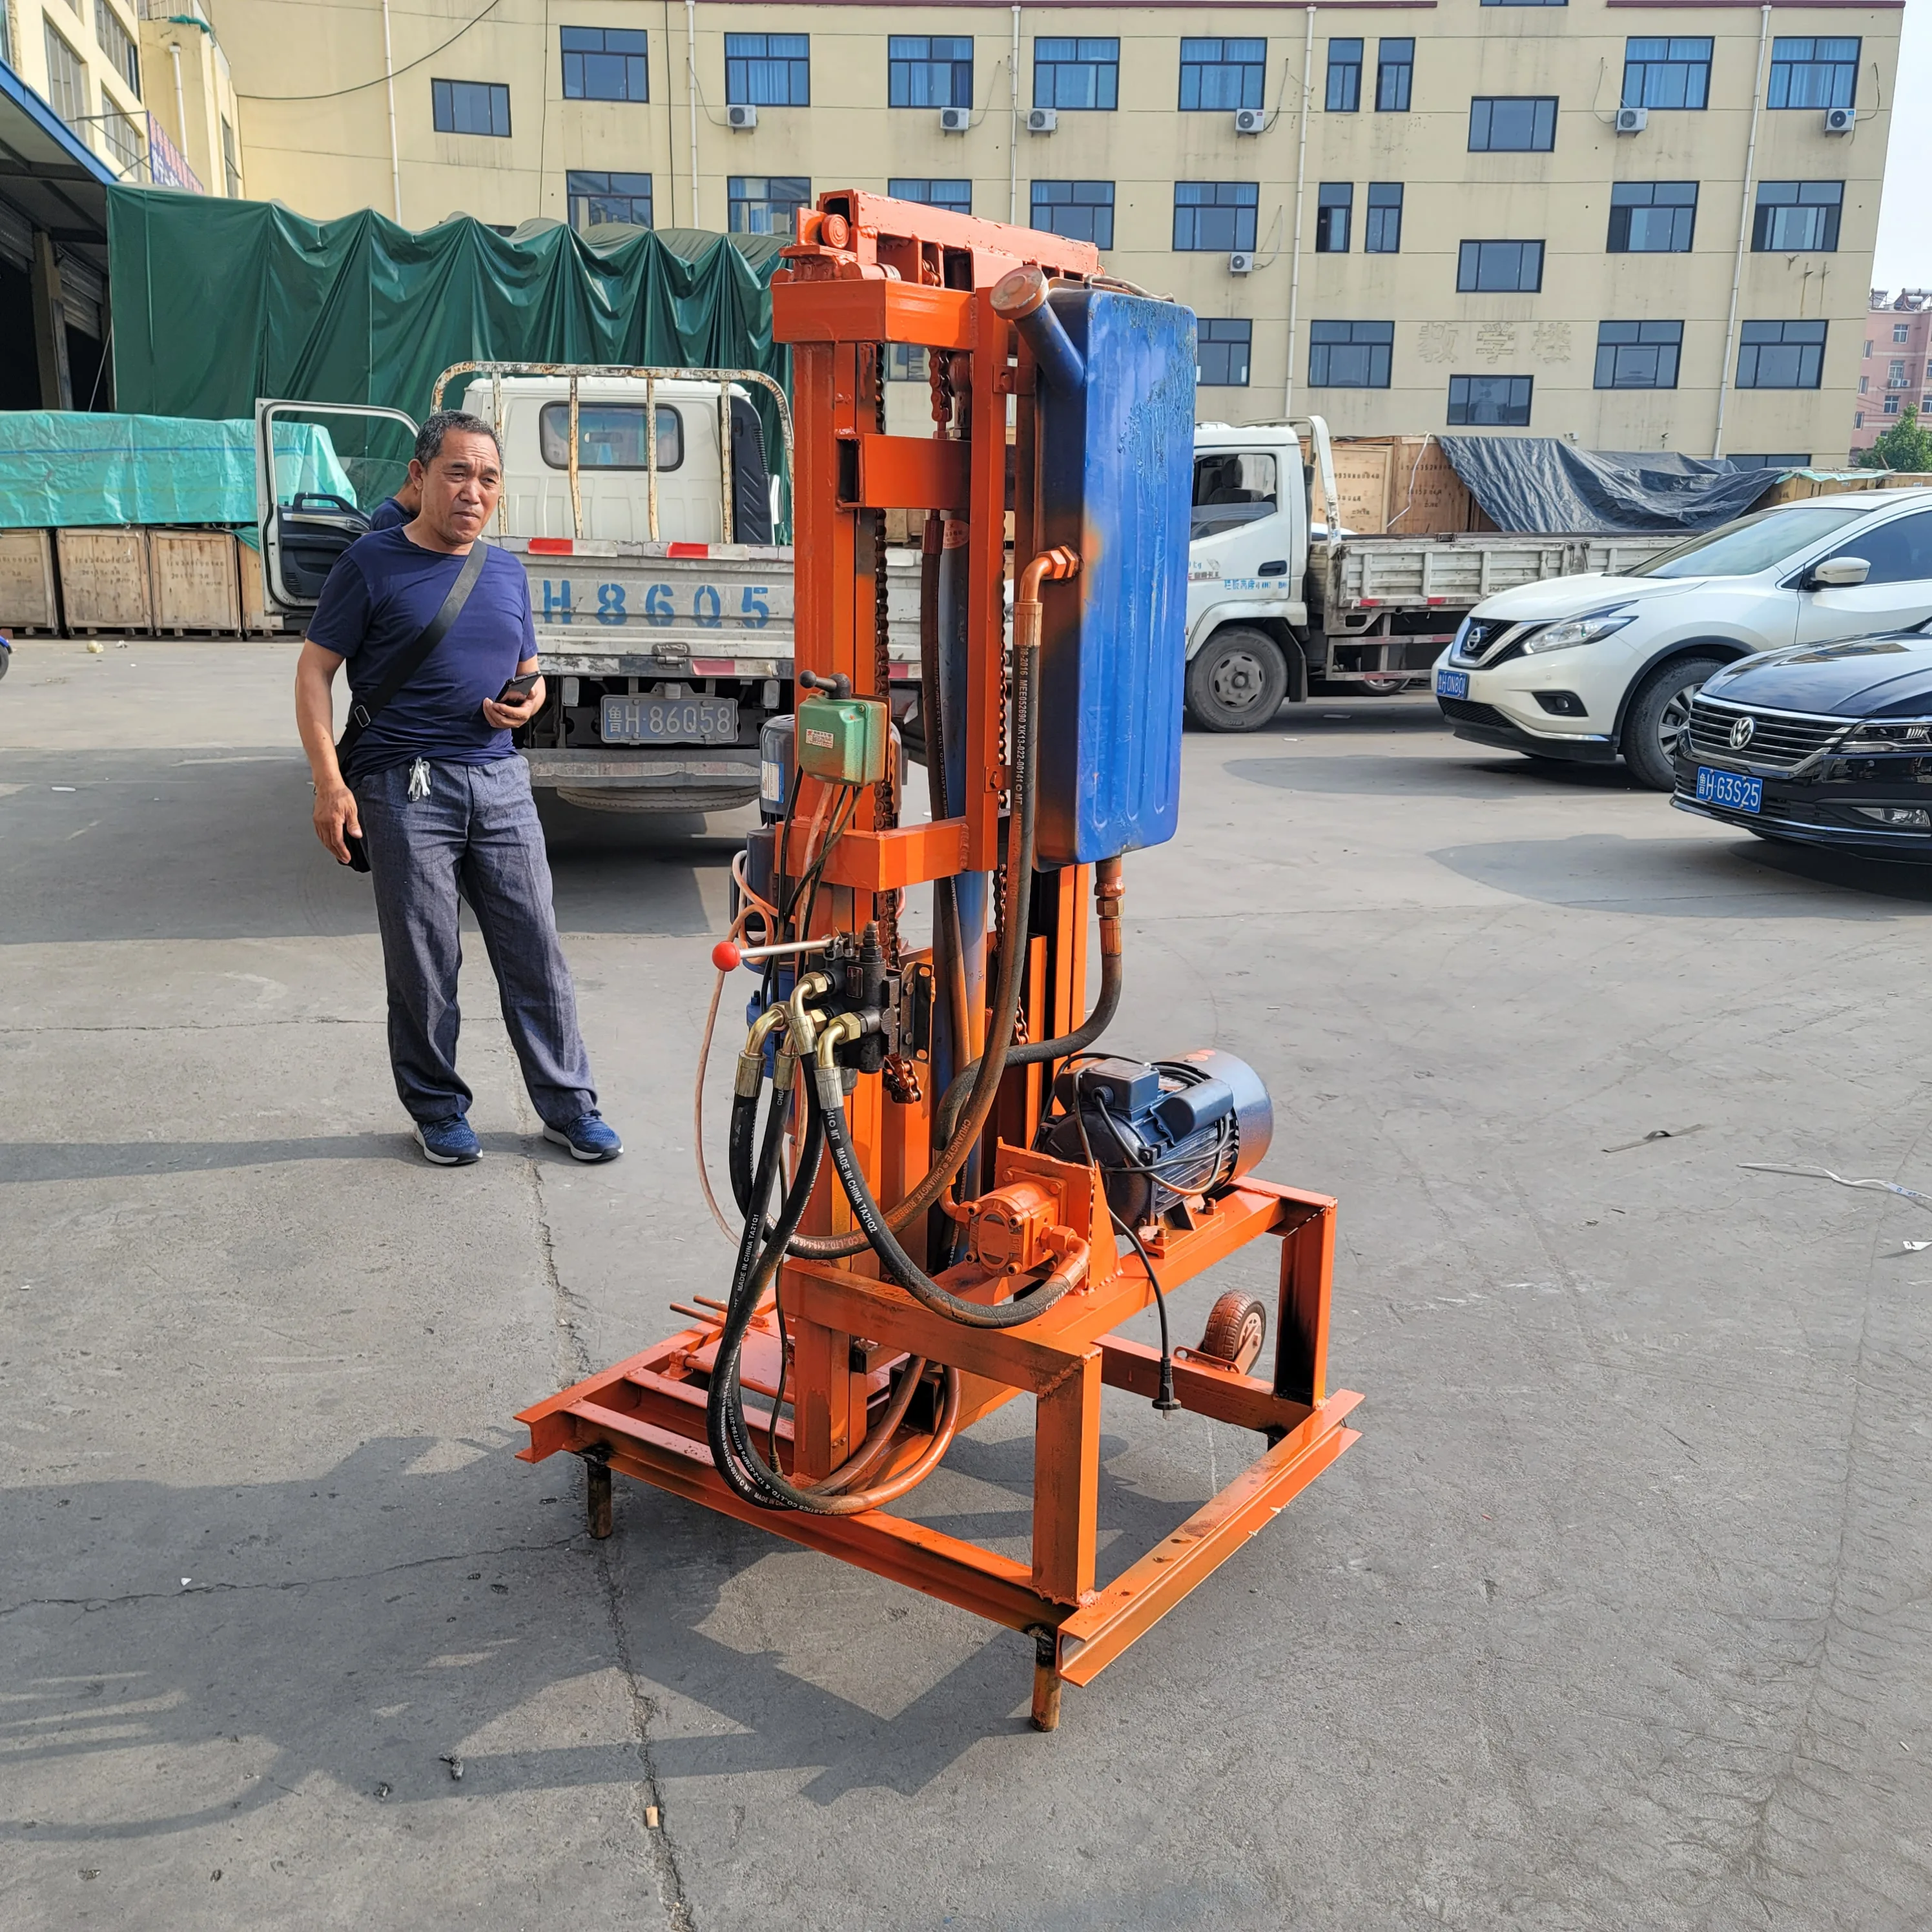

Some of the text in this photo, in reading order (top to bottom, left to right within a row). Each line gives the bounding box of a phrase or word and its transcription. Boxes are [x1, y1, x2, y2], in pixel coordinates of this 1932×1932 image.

[543, 579, 770, 628] H86Q5
[945, 1118, 971, 1162] CHUANGYE
[836, 1147, 850, 1170] MADE
[844, 1170, 853, 1180] IN
[916, 1166, 945, 1201] CHUANGYE
[848, 1179, 863, 1205] CHINA
[858, 1203, 878, 1233] TA21Q2
[737, 1271, 746, 1292] MADE
[743, 1242, 753, 1262] CHINA
[748, 1214, 759, 1240] TA21Q1
[754, 1492, 768, 1504] MADE
